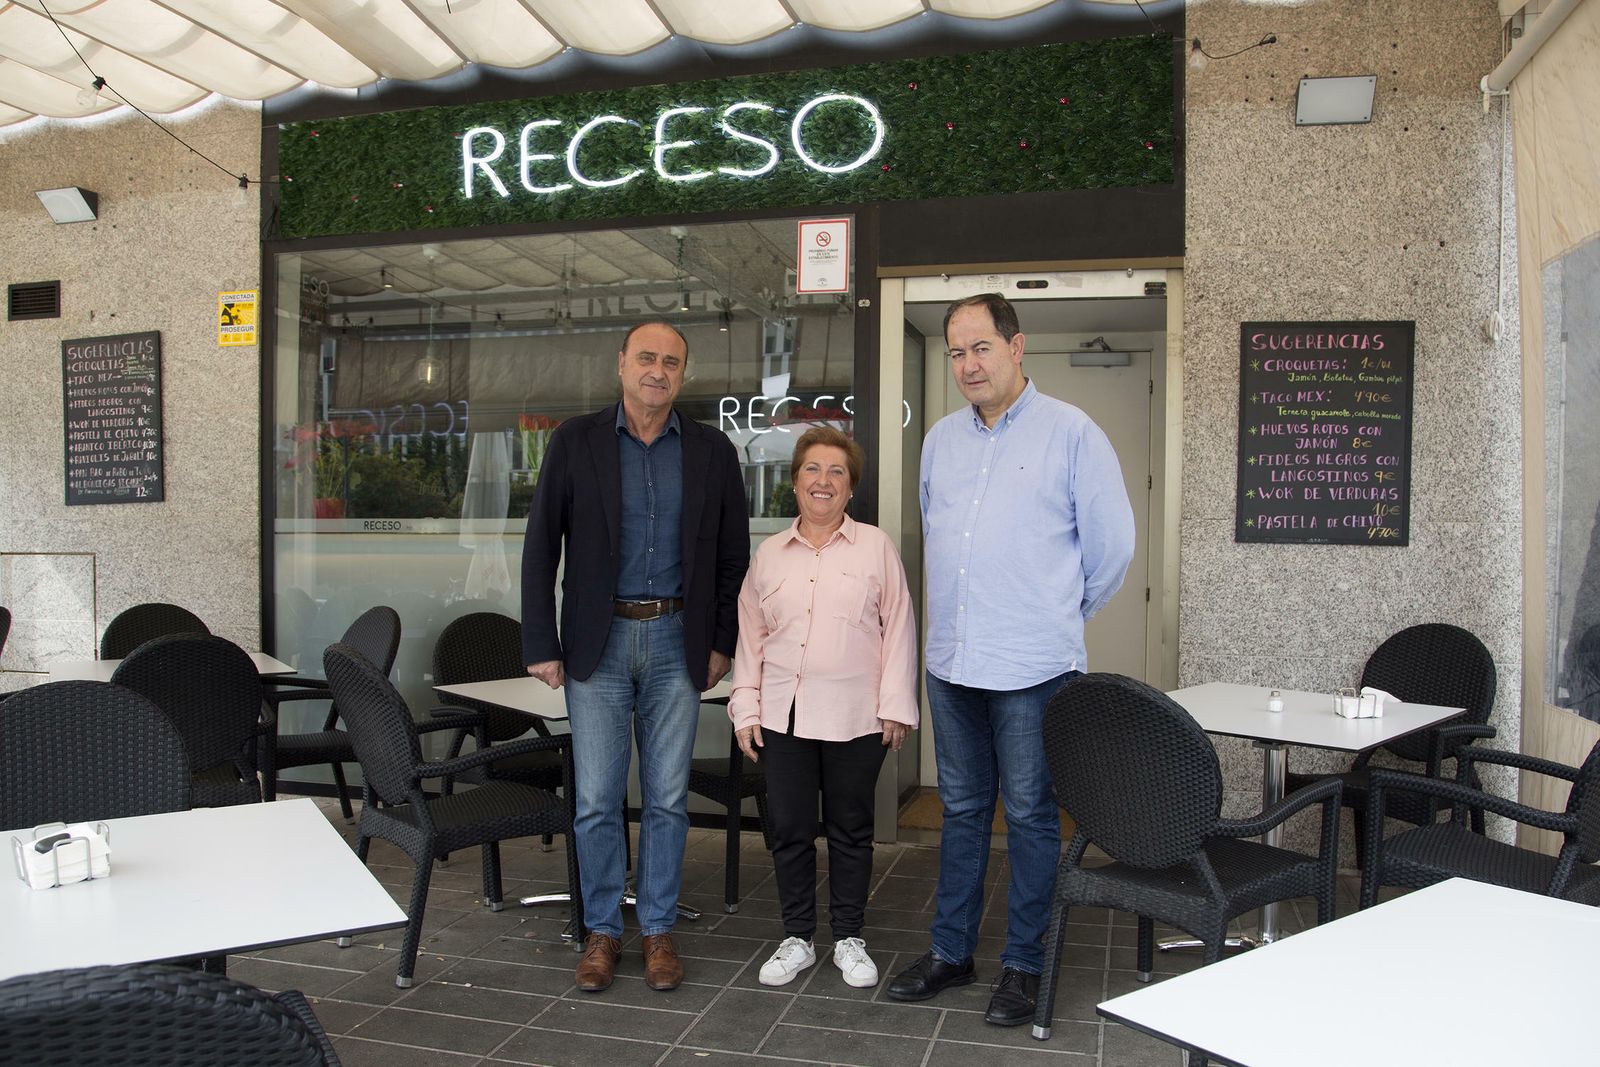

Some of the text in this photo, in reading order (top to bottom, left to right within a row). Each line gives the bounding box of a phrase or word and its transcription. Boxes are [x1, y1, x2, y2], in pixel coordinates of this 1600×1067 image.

[462, 93, 885, 199] RECESO
[1251, 333, 1385, 350] SUGERENCIAS
[68, 339, 153, 359] SUGERENCIAS
[72, 358, 124, 372] CROQUETAS
[74, 375, 94, 385] TACO
[74, 400, 96, 408] FIDEOS
[98, 398, 123, 406] NEGROS
[1260, 392, 1292, 403] TACO
[88, 404, 154, 417] LANGOSTINOS 9€
[73, 420, 90, 429] WOK
[92, 420, 100, 428] DE
[102, 418, 134, 427] VERDURAS
[1261, 424, 1382, 436] HUEVOS ROTOS CON
[73, 430, 101, 440] PASTELA
[103, 430, 112, 439] DE
[115, 428, 138, 439] CHIVO
[1295, 435, 1373, 449] JAMÓN 8€
[1258, 454, 1400, 466] FIDEOS NEGROS CON
[1271, 470, 1396, 483] LANGOSTINOS 9€
[1258, 487, 1399, 500] WOK DE VERDURAS
[1372, 502, 1400, 517] 10€
[363, 520, 402, 531] RECESO
[1257, 515, 1383, 529] PASTELA DE CHIVO
